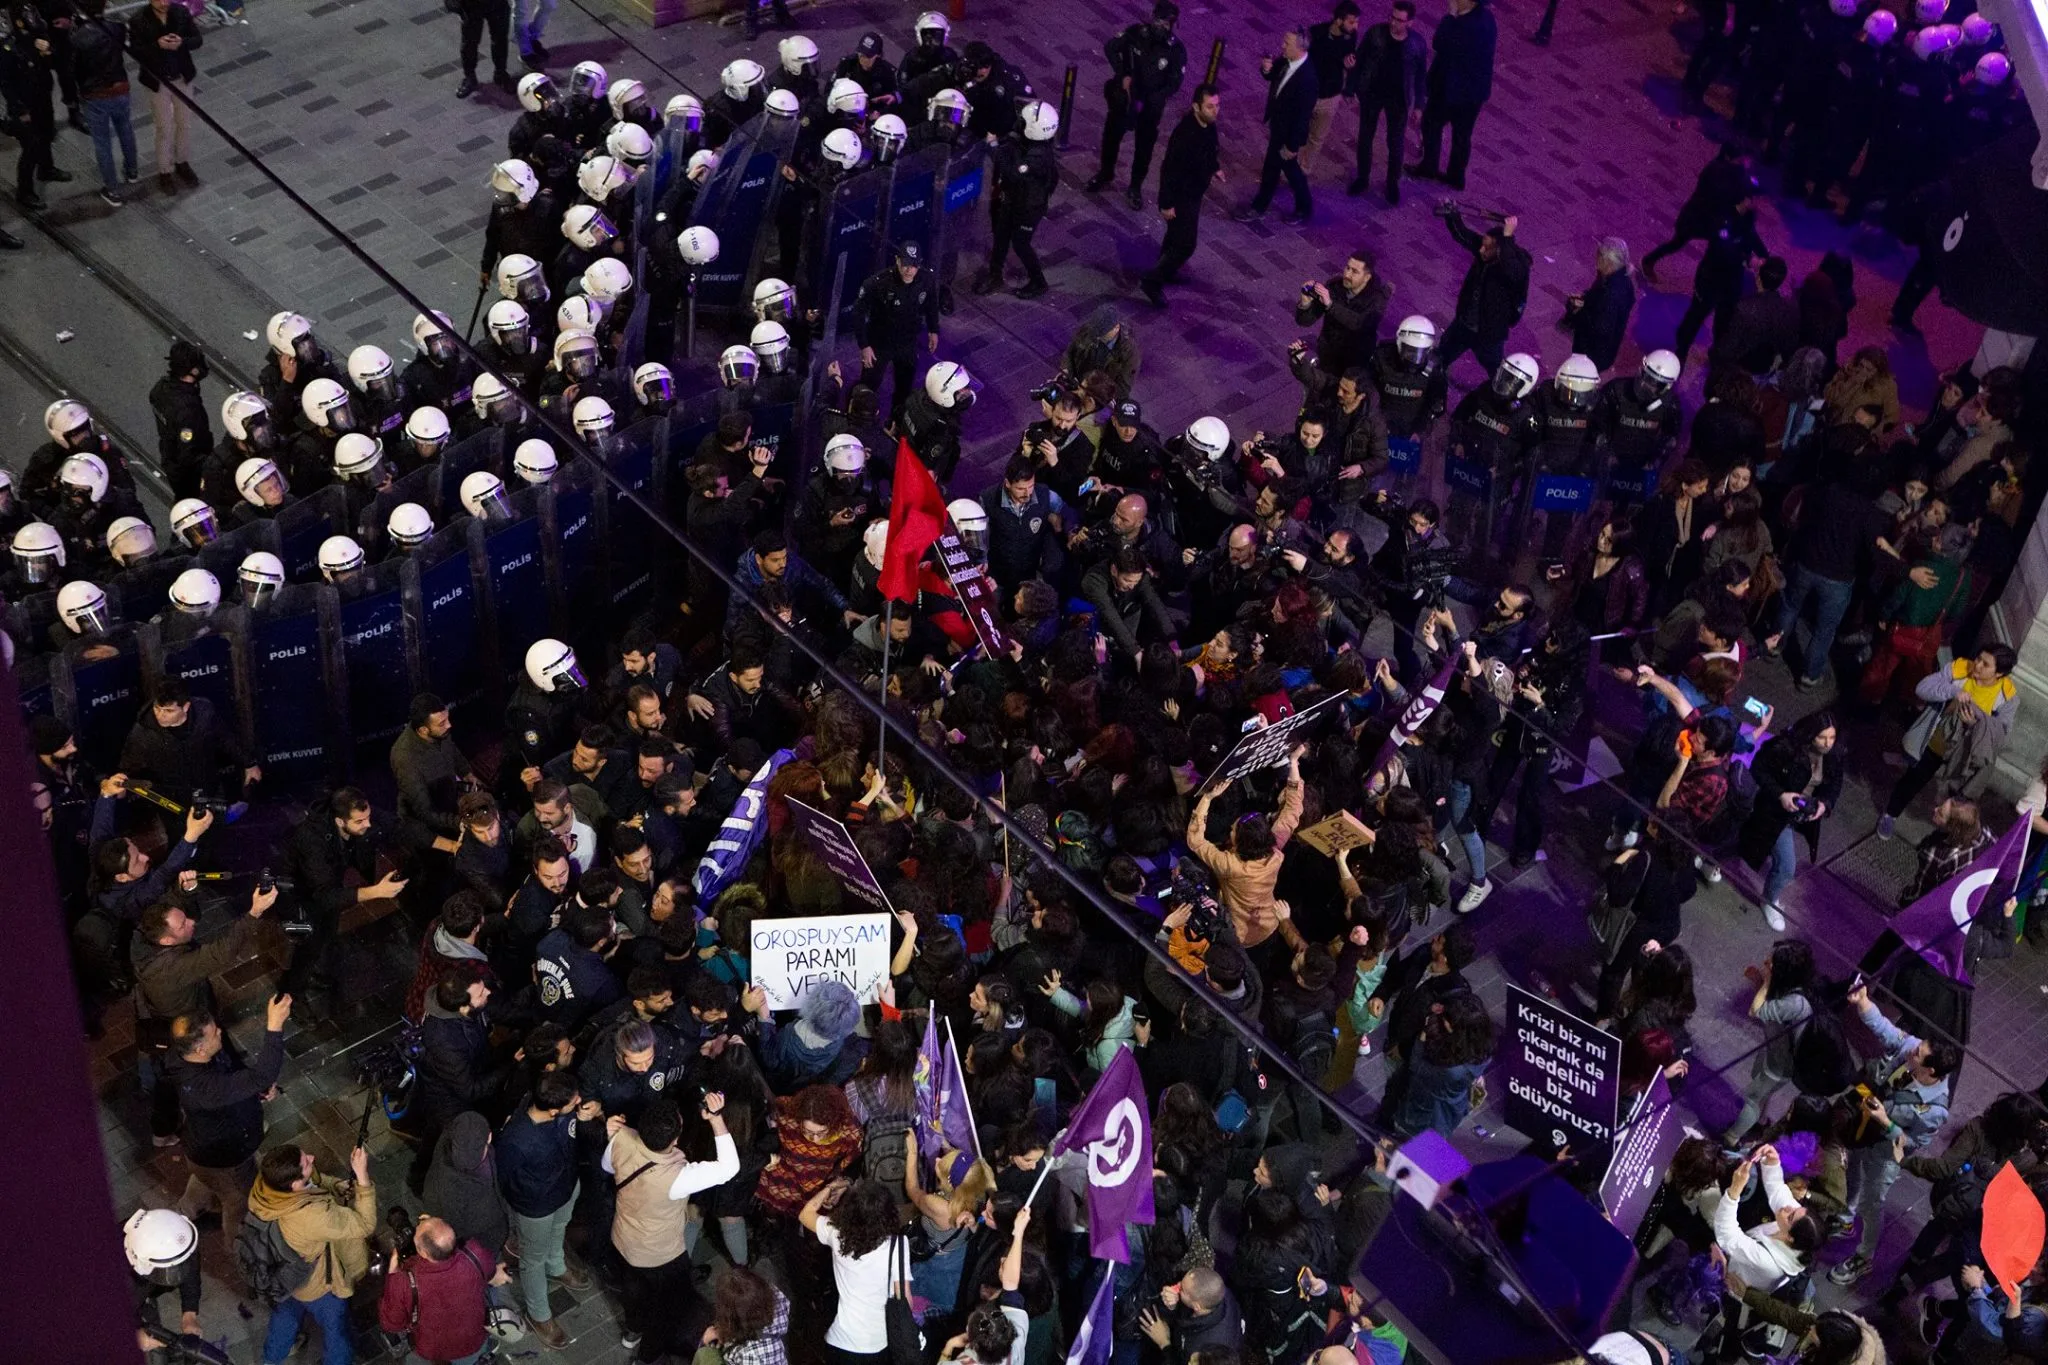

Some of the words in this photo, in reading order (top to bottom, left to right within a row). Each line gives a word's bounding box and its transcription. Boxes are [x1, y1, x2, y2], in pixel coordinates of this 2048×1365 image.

[951, 182, 975, 200] POLİS
[900, 200, 925, 215] POLİS
[1453, 467, 1483, 488] POLİS
[1612, 479, 1644, 493] POLİS
[1545, 487, 1580, 501] POLİS
[563, 514, 588, 540] POLİS
[501, 552, 533, 575] POLİS
[432, 586, 463, 610] POLİS
[357, 622, 392, 642] POLİS
[269, 645, 307, 661] POLİS
[181, 664, 219, 680] POLİS
[92, 687, 130, 707] POLİS
[268, 750, 291, 763] ÇEVİK
[292, 746, 324, 760] KUVVET
[753, 923, 887, 951] OROSPUYSAM
[786, 947, 856, 972] PARAMI
[1517, 1003, 1554, 1034] Krizi
[1558, 1023, 1582, 1048] biz
[1586, 1042, 1607, 1061] mi
[1517, 1027, 1581, 1069] çıkardık
[1585, 1060, 1605, 1081] da
[1524, 1045, 1597, 1098] bedelini
[1546, 1077, 1572, 1104] biz
[1508, 1076, 1609, 1144] ödüyoruz?!
